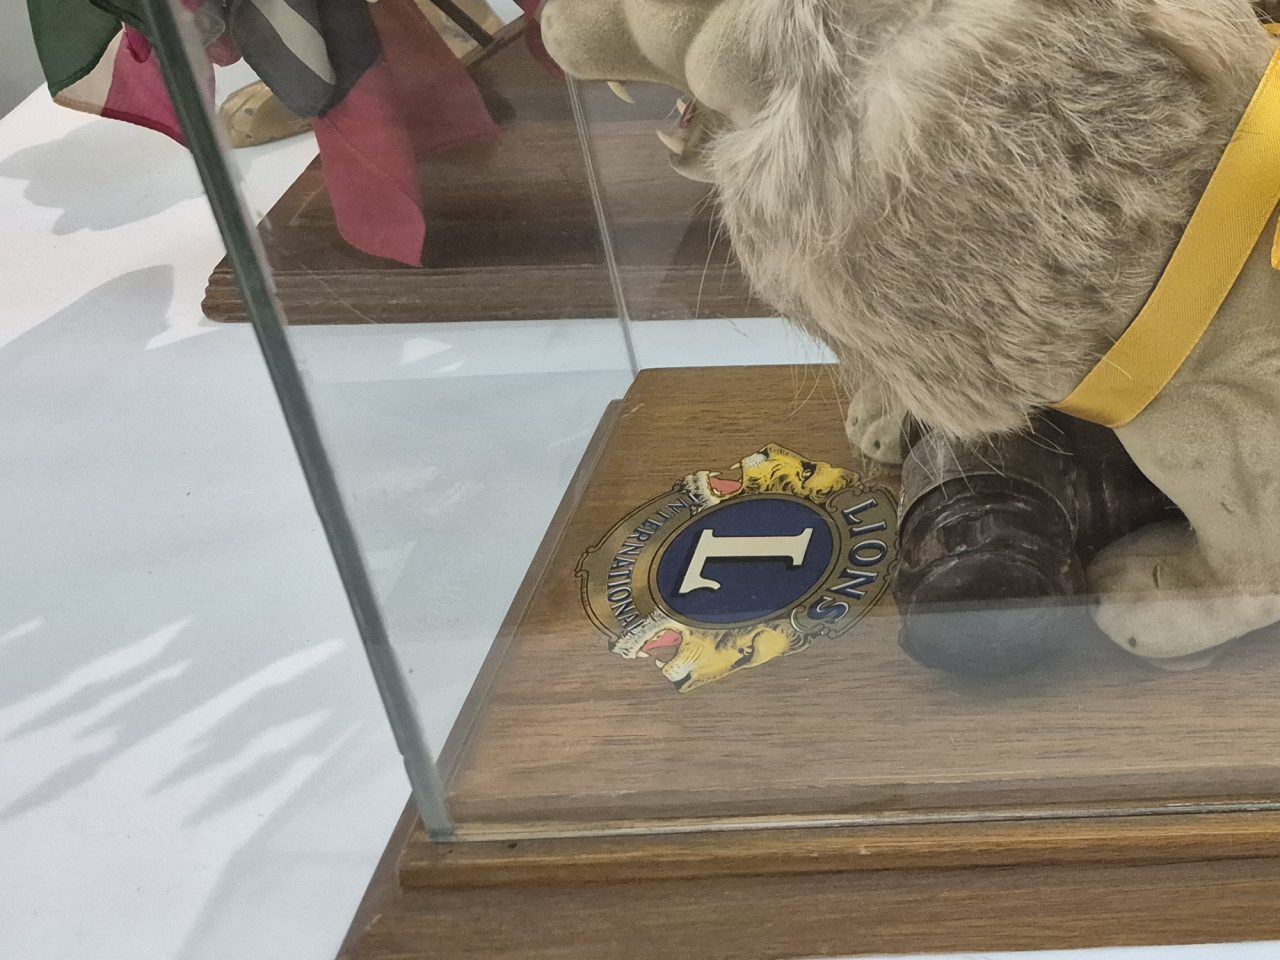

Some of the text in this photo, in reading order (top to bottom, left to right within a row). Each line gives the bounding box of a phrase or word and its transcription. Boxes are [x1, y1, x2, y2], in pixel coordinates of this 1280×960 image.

[607, 493, 699, 632] INTERNATIONAL
[678, 527, 814, 594] L
[809, 497, 887, 623] LIONS
